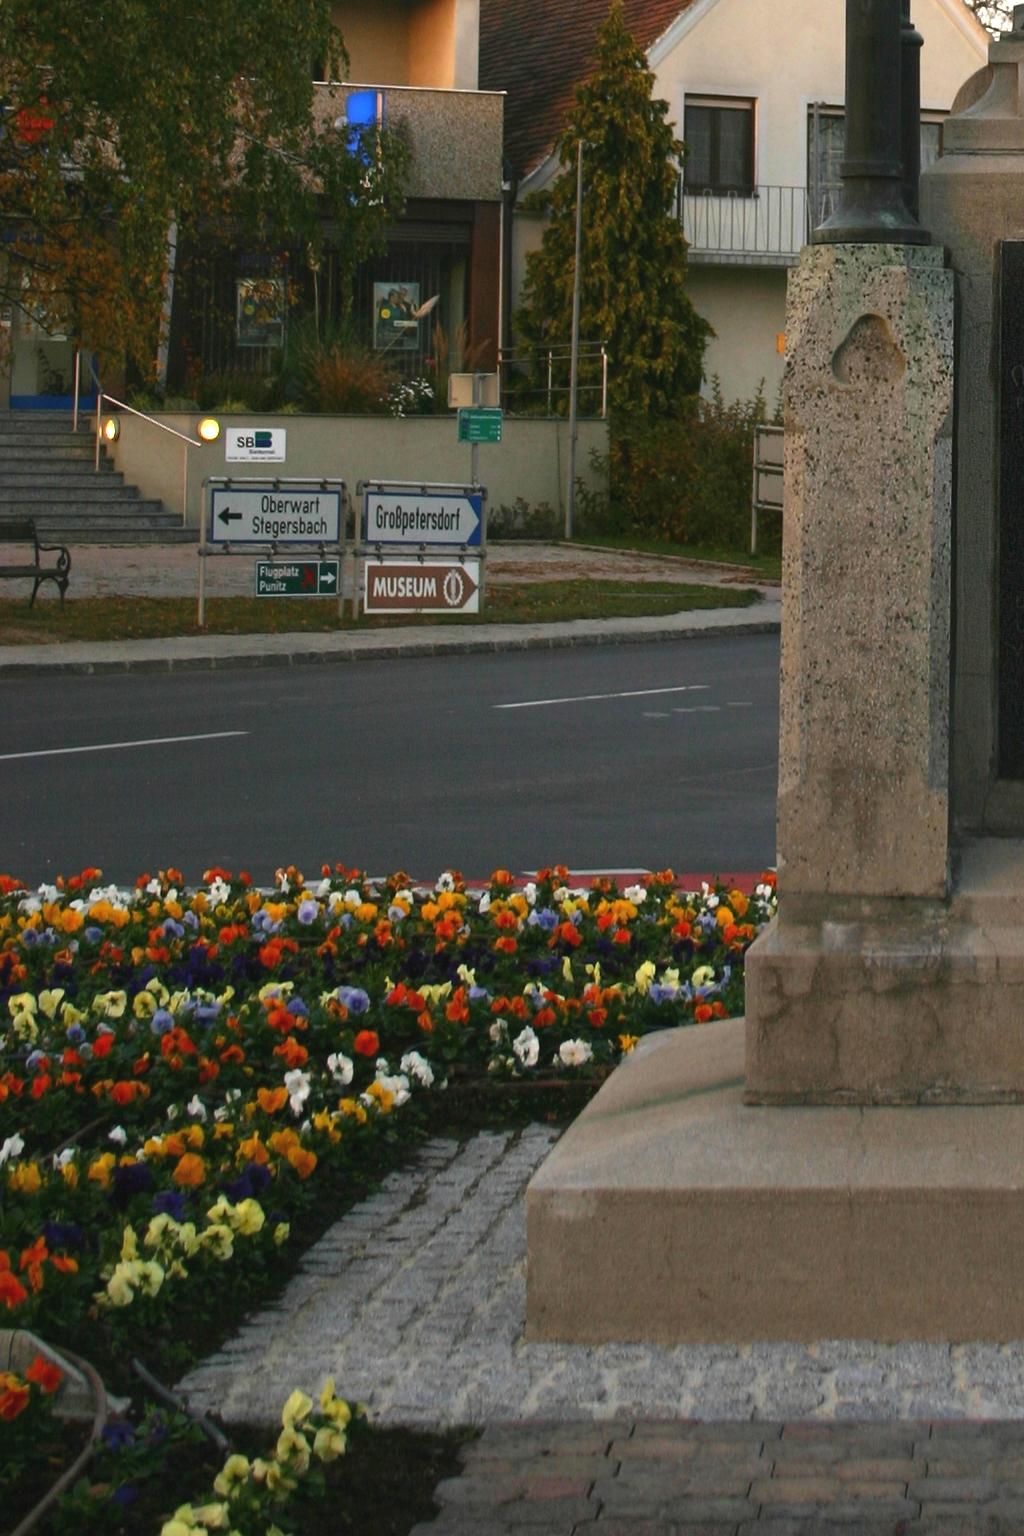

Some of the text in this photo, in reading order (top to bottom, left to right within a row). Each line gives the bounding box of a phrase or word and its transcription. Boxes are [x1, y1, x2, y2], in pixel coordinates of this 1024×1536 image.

[261, 495, 320, 514] Oberwart
[252, 517, 327, 538] Stegersbach
[376, 504, 461, 535] Großpetersdorf
[259, 566, 300, 579] Flugplatz
[259, 581, 287, 592] Punitz
[373, 577, 437, 598] MUSEUM
